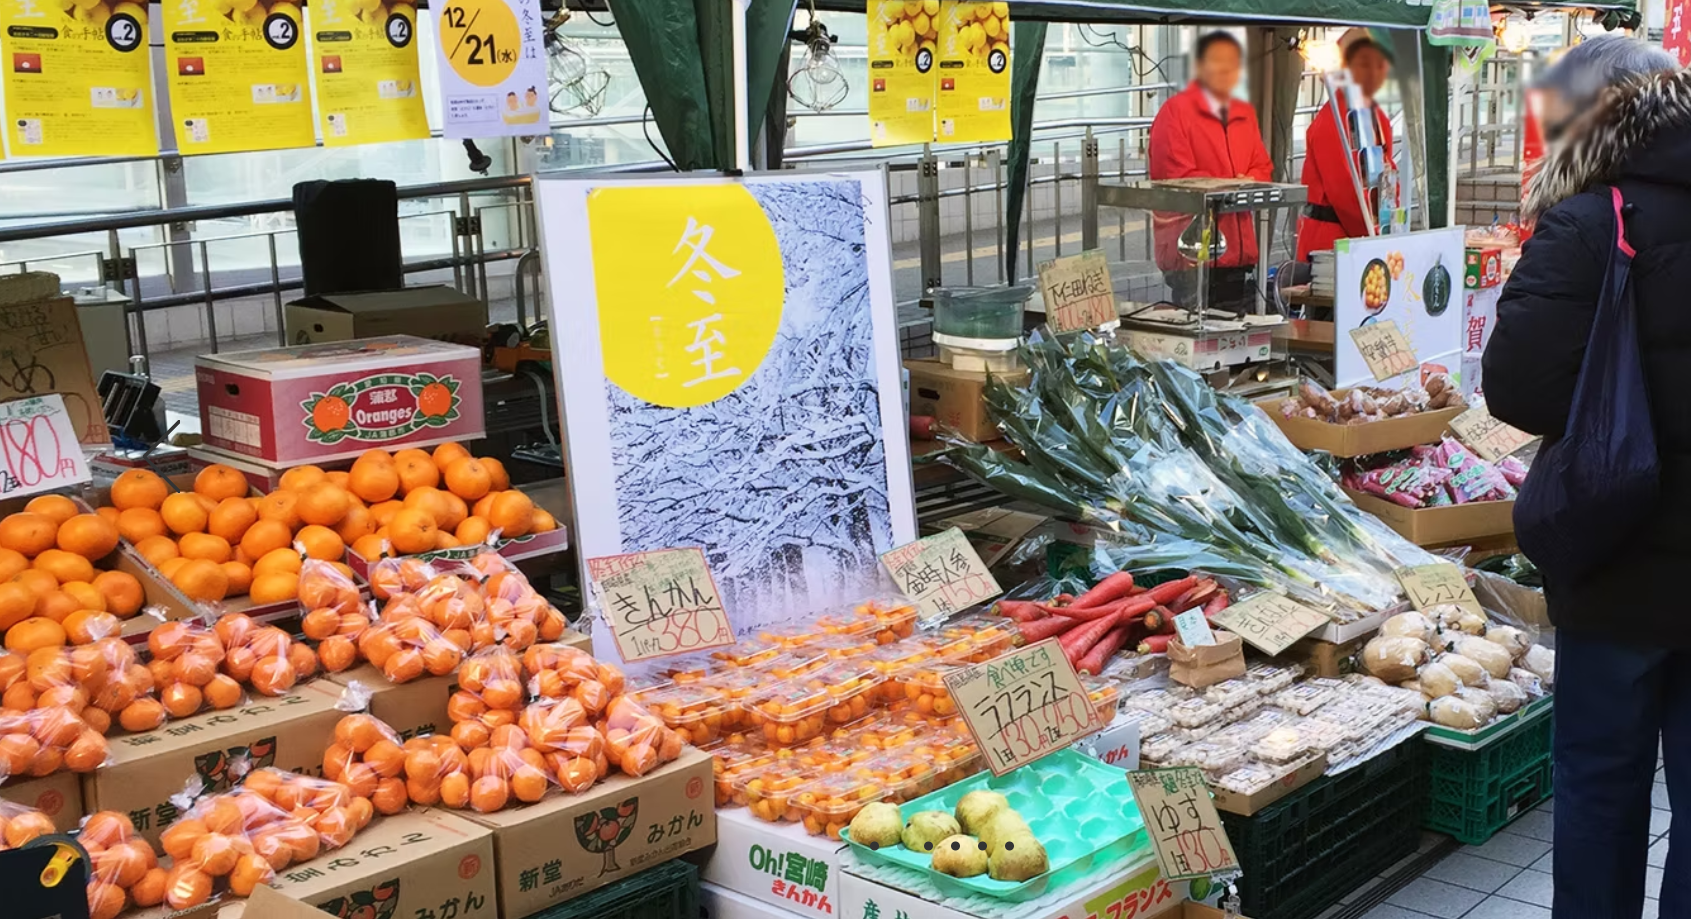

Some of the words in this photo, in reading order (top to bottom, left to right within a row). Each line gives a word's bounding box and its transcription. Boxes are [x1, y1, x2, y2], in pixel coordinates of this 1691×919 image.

[666, 215, 742, 388] 冬至
[1048, 266, 1107, 306] 下仁田ねぎ
[356, 407, 412, 425] Oranges
[905, 548, 971, 596] 金時人参
[612, 576, 713, 624] きんかん
[1412, 583, 1466, 606] レンコン
[986, 646, 1056, 690] 食べ頃です
[973, 670, 1069, 730] ラフランス
[1099, 744, 1129, 765] かん
[129, 802, 180, 832] 新堂
[647, 809, 704, 845] みかん
[1151, 788, 1202, 833] ゆず
[519, 857, 563, 893] 新堂
[771, 879, 832, 914] きんかん
